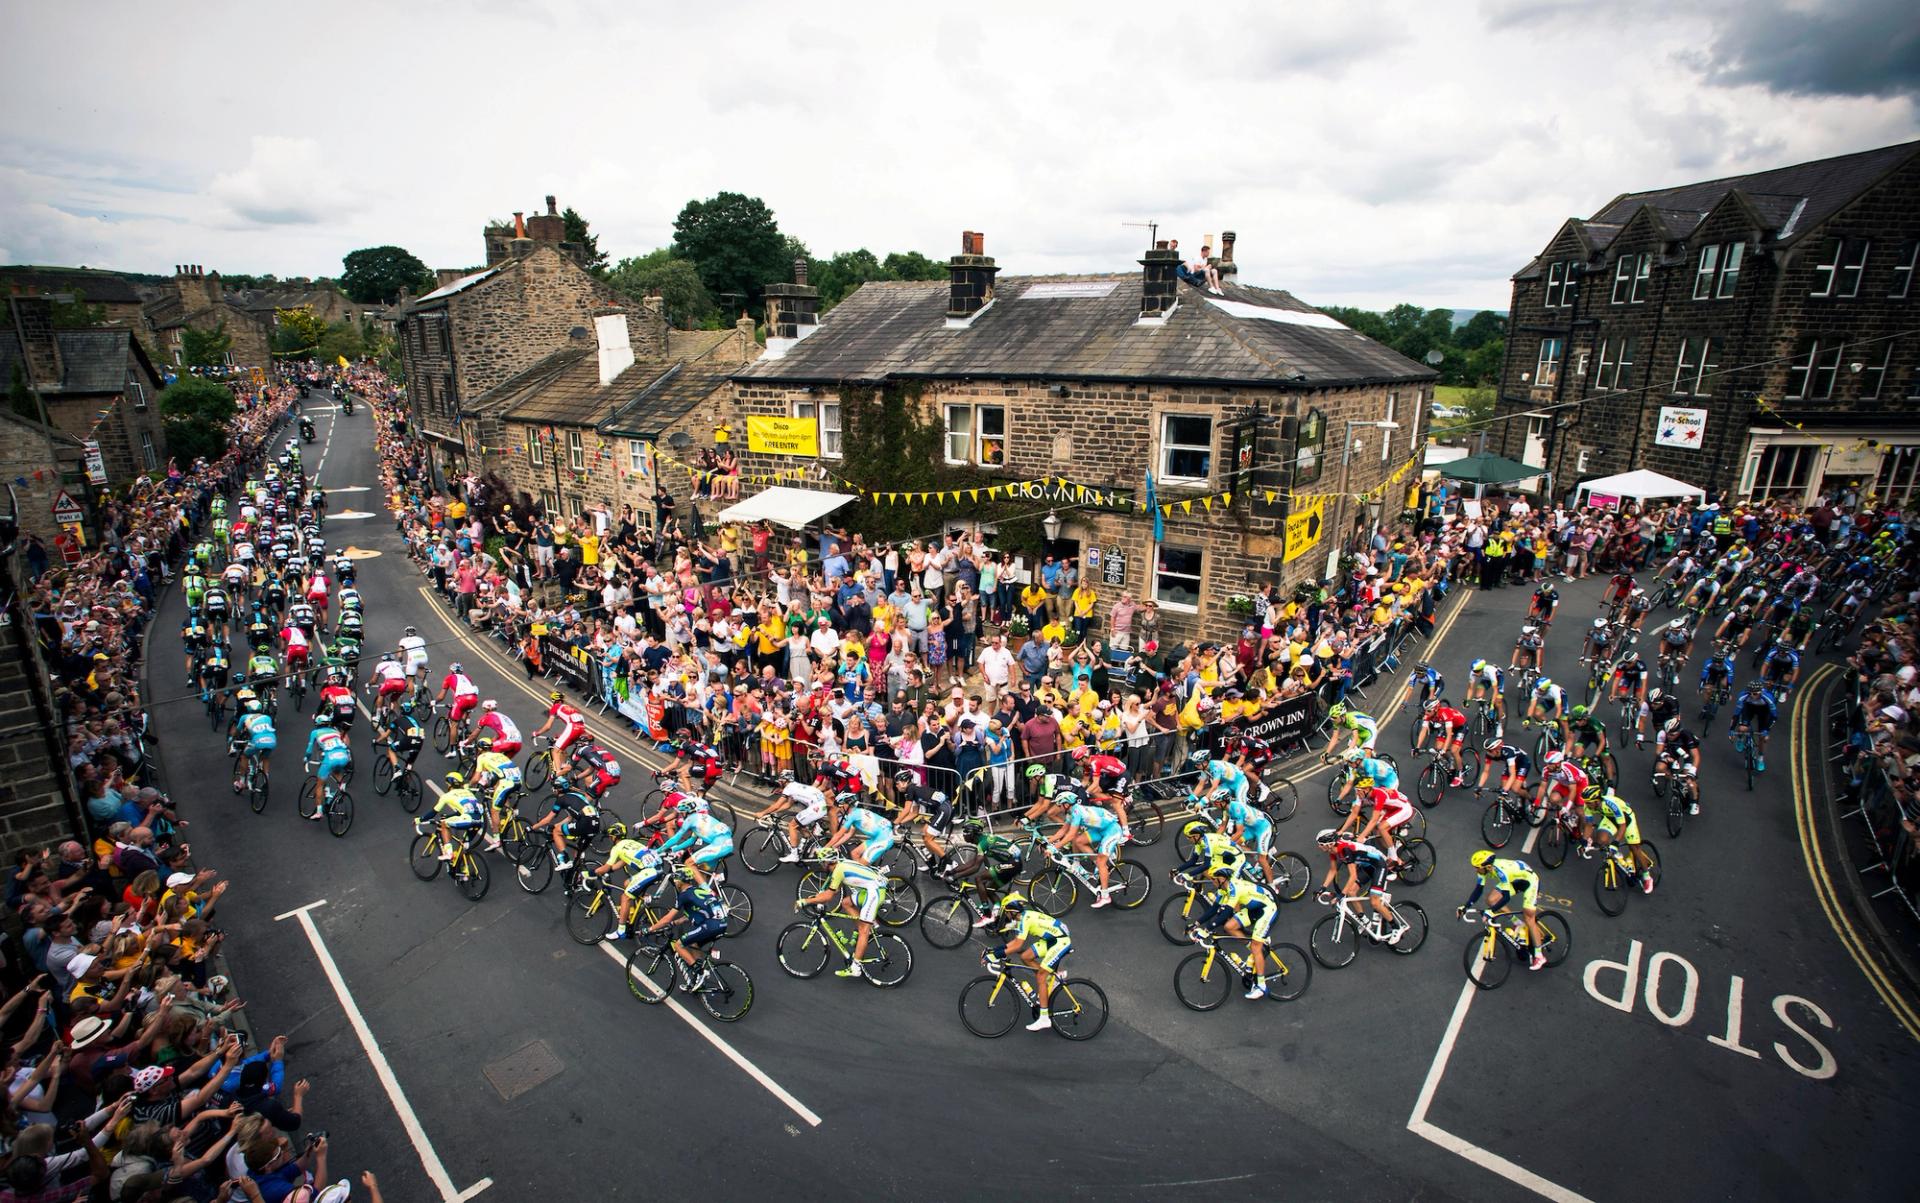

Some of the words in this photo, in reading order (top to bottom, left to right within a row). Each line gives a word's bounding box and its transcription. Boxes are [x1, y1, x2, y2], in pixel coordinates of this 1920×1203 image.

[773, 422, 789, 430] Disco
[764, 440, 779, 449] FREE
[780, 442, 799, 450] ENTRY
[1008, 481, 1075, 503] CROWN
[1080, 488, 1114, 507] INN
[1244, 716, 1285, 738] CROWN
[1286, 709, 1306, 726] INN
[1583, 938, 1839, 1080] STOP
